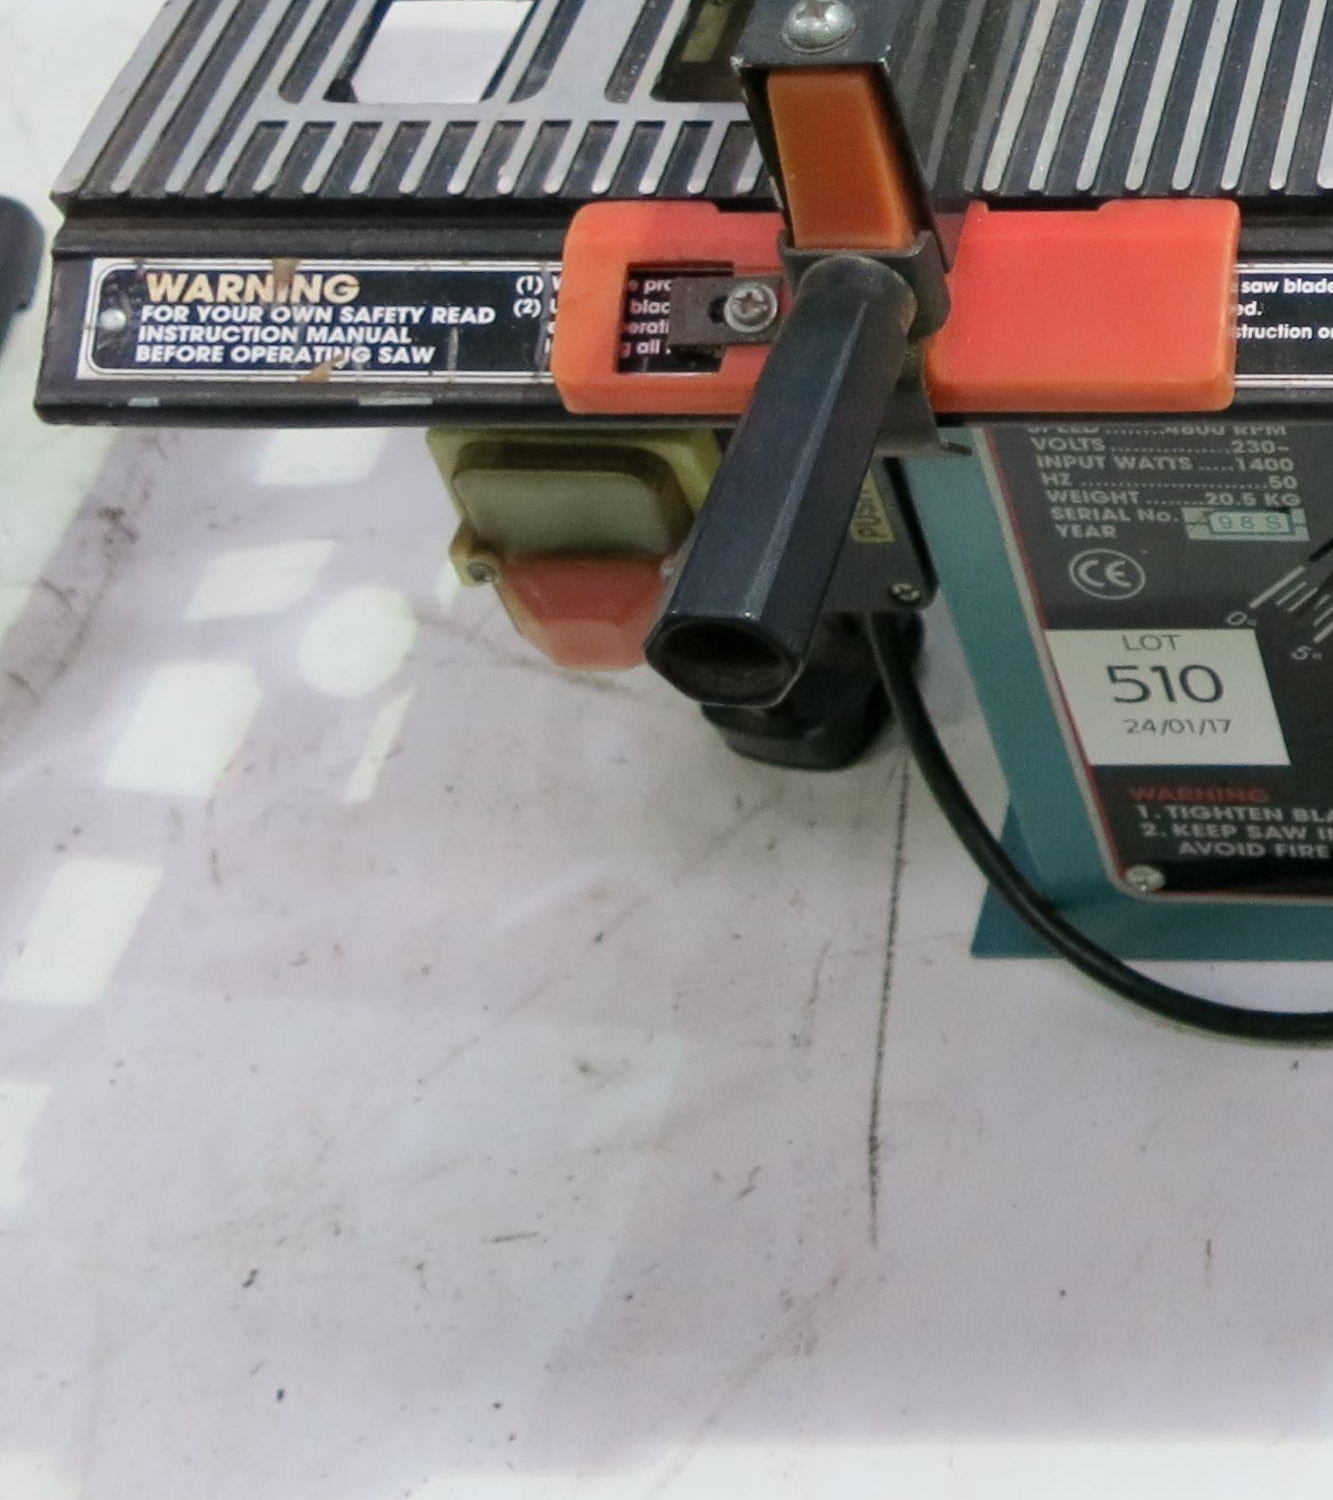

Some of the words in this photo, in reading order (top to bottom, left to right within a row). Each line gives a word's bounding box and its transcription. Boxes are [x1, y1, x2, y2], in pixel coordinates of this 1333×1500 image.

[144, 272, 361, 303] WARNING
[516, 276, 544, 295] (1)
[1241, 280, 1279, 293] saw
[141, 305, 190, 324] FOR
[199, 305, 266, 324] YOUR
[271, 306, 333, 324] OWN
[341, 306, 427, 325] SAFETY
[432, 306, 496, 325] READ
[513, 299, 541, 319] (2)
[138, 325, 298, 344] INSTRUCTION
[306, 326, 413, 344] MANUAL
[135, 345, 224, 364] BEFORE
[231, 346, 372, 365] OPERATING
[378, 346, 436, 364] SAW
[1030, 437, 1106, 452] VOLTS
[1036, 455, 1105, 469] INPUT
[1114, 456, 1193, 471] WATTS
[1235, 457, 1294, 472] 1400
[1268, 475, 1298, 490] 50
[1046, 489, 1140, 505] WEIGHT
[1264, 493, 1301, 508] KG
[1051, 506, 1131, 522] SERIAL
[1055, 523, 1117, 539] YEAR
[1122, 634, 1181, 651] LOT
[1106, 664, 1224, 704] 510
[1124, 718, 1232, 736] 24/01/17
[1129, 786, 1271, 804] WARNING
[1166, 805, 1283, 822] TIGHTEN
[1172, 823, 1239, 839] KEEP
[1247, 825, 1307, 841] SAW
[1179, 841, 1266, 858] AVOID
[1276, 843, 1331, 860] FIRE
